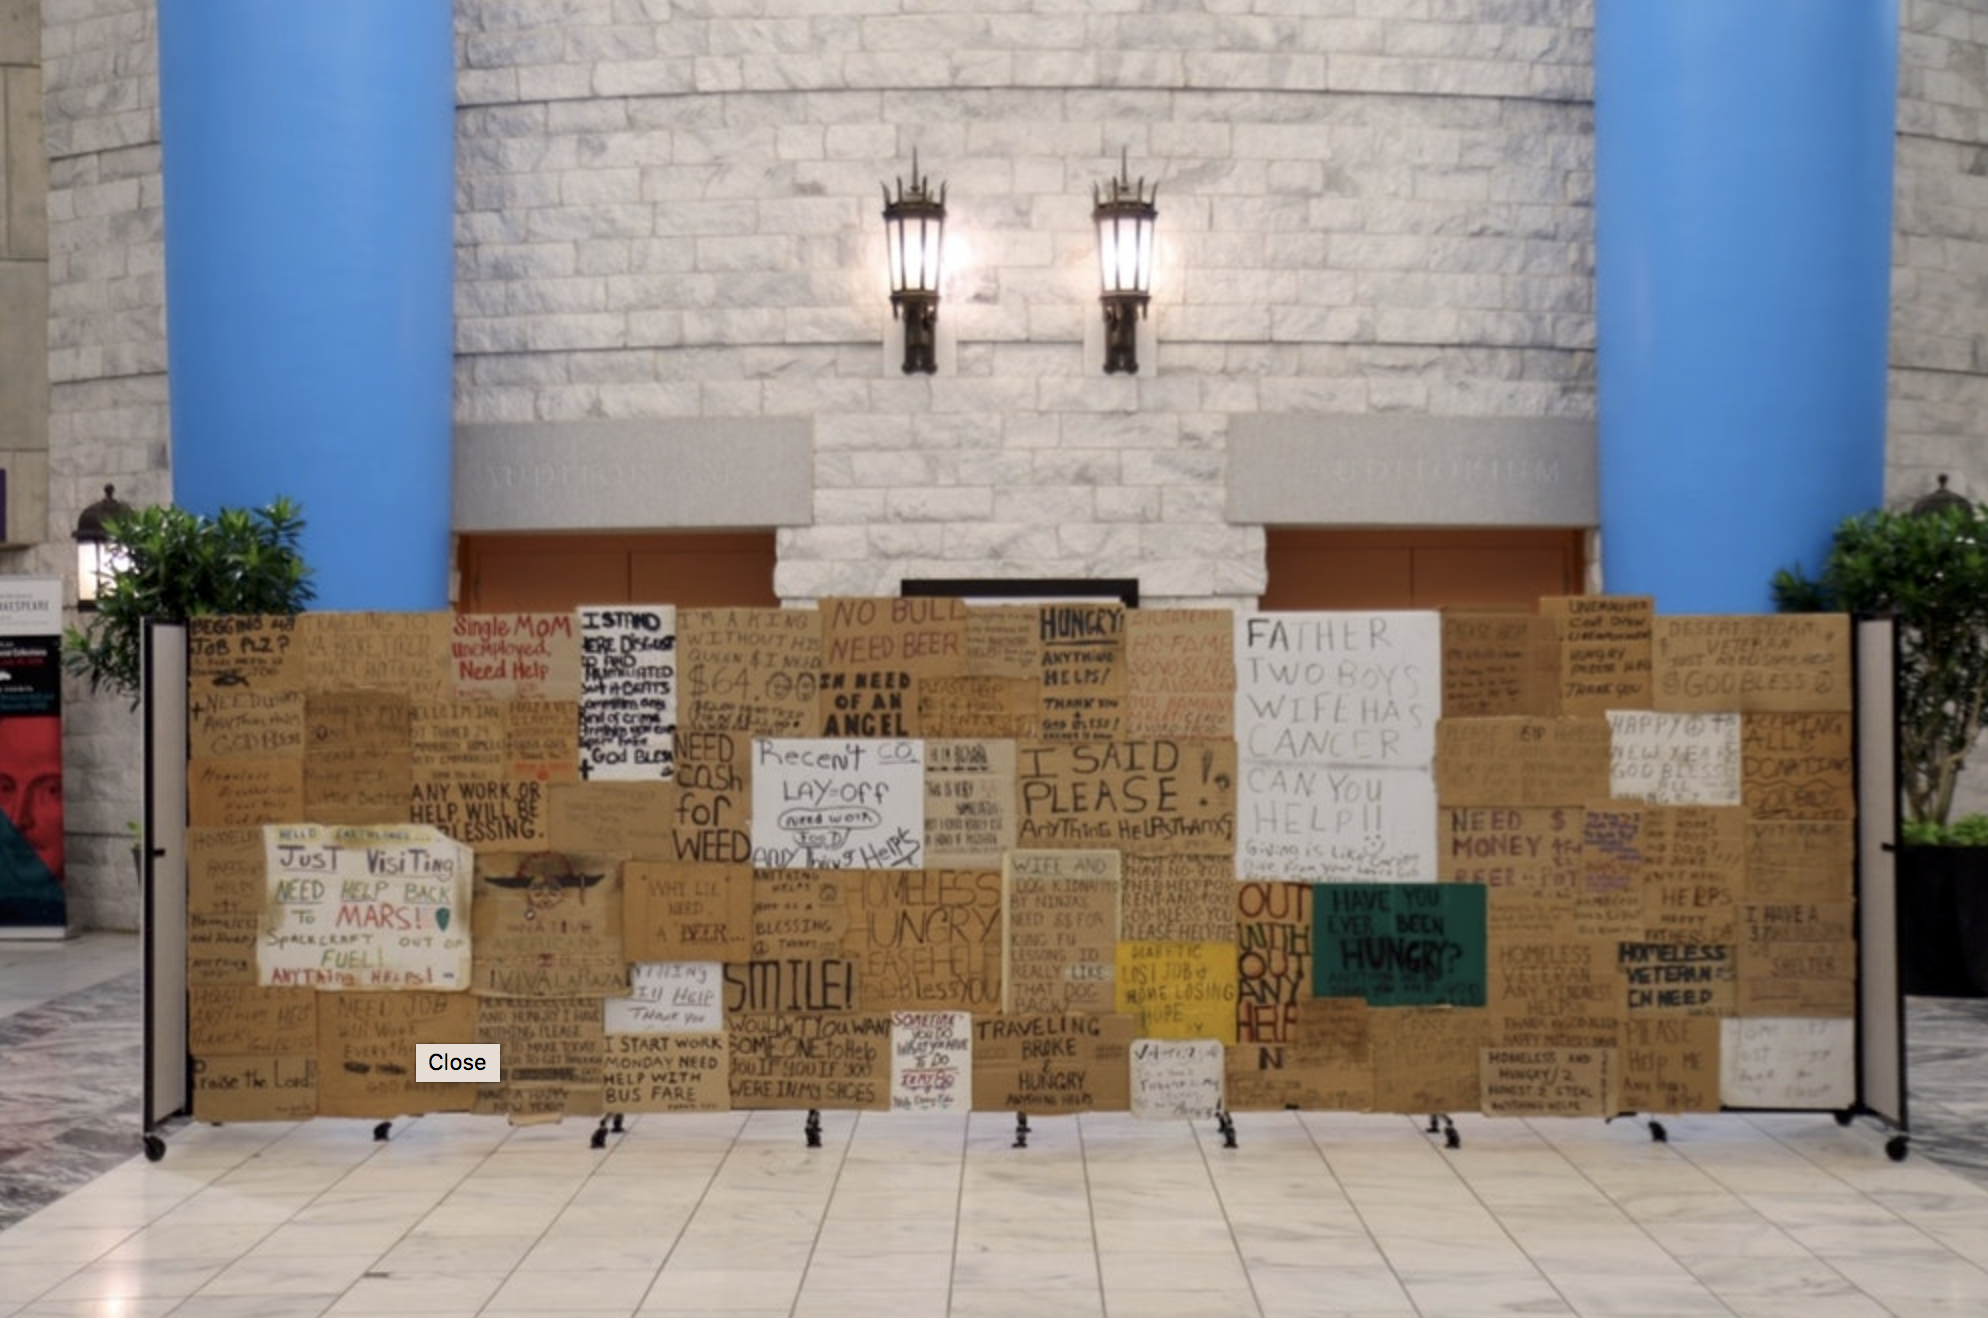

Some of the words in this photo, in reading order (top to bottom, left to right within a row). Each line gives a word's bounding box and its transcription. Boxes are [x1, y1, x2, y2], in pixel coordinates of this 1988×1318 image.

[583, 613, 599, 629] I
[832, 599, 877, 629] NO
[890, 598, 967, 625] BULL
[453, 616, 510, 643] Single
[1246, 616, 1395, 652] FATHER
[830, 633, 895, 664] NEED
[903, 630, 960, 660] BEER
[459, 659, 506, 681] Need
[513, 659, 549, 682] Help
[855, 671, 912, 690] NEED
[1247, 657, 1325, 687] TWO
[1337, 659, 1420, 700] BOYS
[1683, 669, 1736, 699] GOD
[834, 694, 862, 711] OF
[871, 693, 904, 711] AN
[1246, 690, 1352, 725] WIFE
[1361, 695, 1423, 730] HAS
[822, 712, 911, 738] ANGEL
[673, 730, 736, 763] NEED
[1248, 724, 1402, 760] CANCER
[1019, 747, 1059, 779] I
[1070, 740, 1180, 775] SAID
[411, 782, 451, 802] ANY
[458, 781, 510, 802] WORK
[518, 781, 542, 802] OR
[1021, 776, 1178, 817] PLEASE
[1247, 767, 1317, 799] CAN
[1327, 772, 1383, 804] YOU
[409, 803, 458, 825] HELP
[464, 802, 512, 824] WILL
[517, 802, 541, 820] BE
[1451, 805, 1524, 834] NEED
[672, 828, 751, 863] WEED
[1452, 832, 1543, 859] MONEY
[277, 878, 326, 902] NEED
[342, 878, 390, 902] HELP
[404, 882, 451, 902] BACK
[1238, 882, 1312, 922] OUT
[1330, 887, 1393, 914] HAVE
[1401, 885, 1441, 908] YOU
[336, 902, 422, 932] MARS!
[1396, 912, 1446, 937] BEEN
[1617, 942, 1728, 966] HOMELESS
[722, 958, 854, 1013] SMILE!
[1071, 964, 1106, 981] LIKE
[1627, 965, 1713, 985] VETERAN
[1656, 987, 1715, 1009] NEED
[975, 1015, 1101, 1042] TRAVELING
[603, 1035, 616, 1053] I
[620, 1035, 673, 1054] START
[675, 1036, 723, 1051] WORK
[1019, 1036, 1079, 1061] BROKE
[604, 1055, 672, 1071] MONDAY
[678, 1054, 719, 1071] NEED
[603, 1071, 646, 1087] HELP
[652, 1071, 702, 1084] WITH
[728, 1080, 775, 1100] WERE
[1017, 1069, 1089, 1093] HUNGRY
[605, 1087, 643, 1104] BUS
[651, 1085, 698, 1103] FARE
